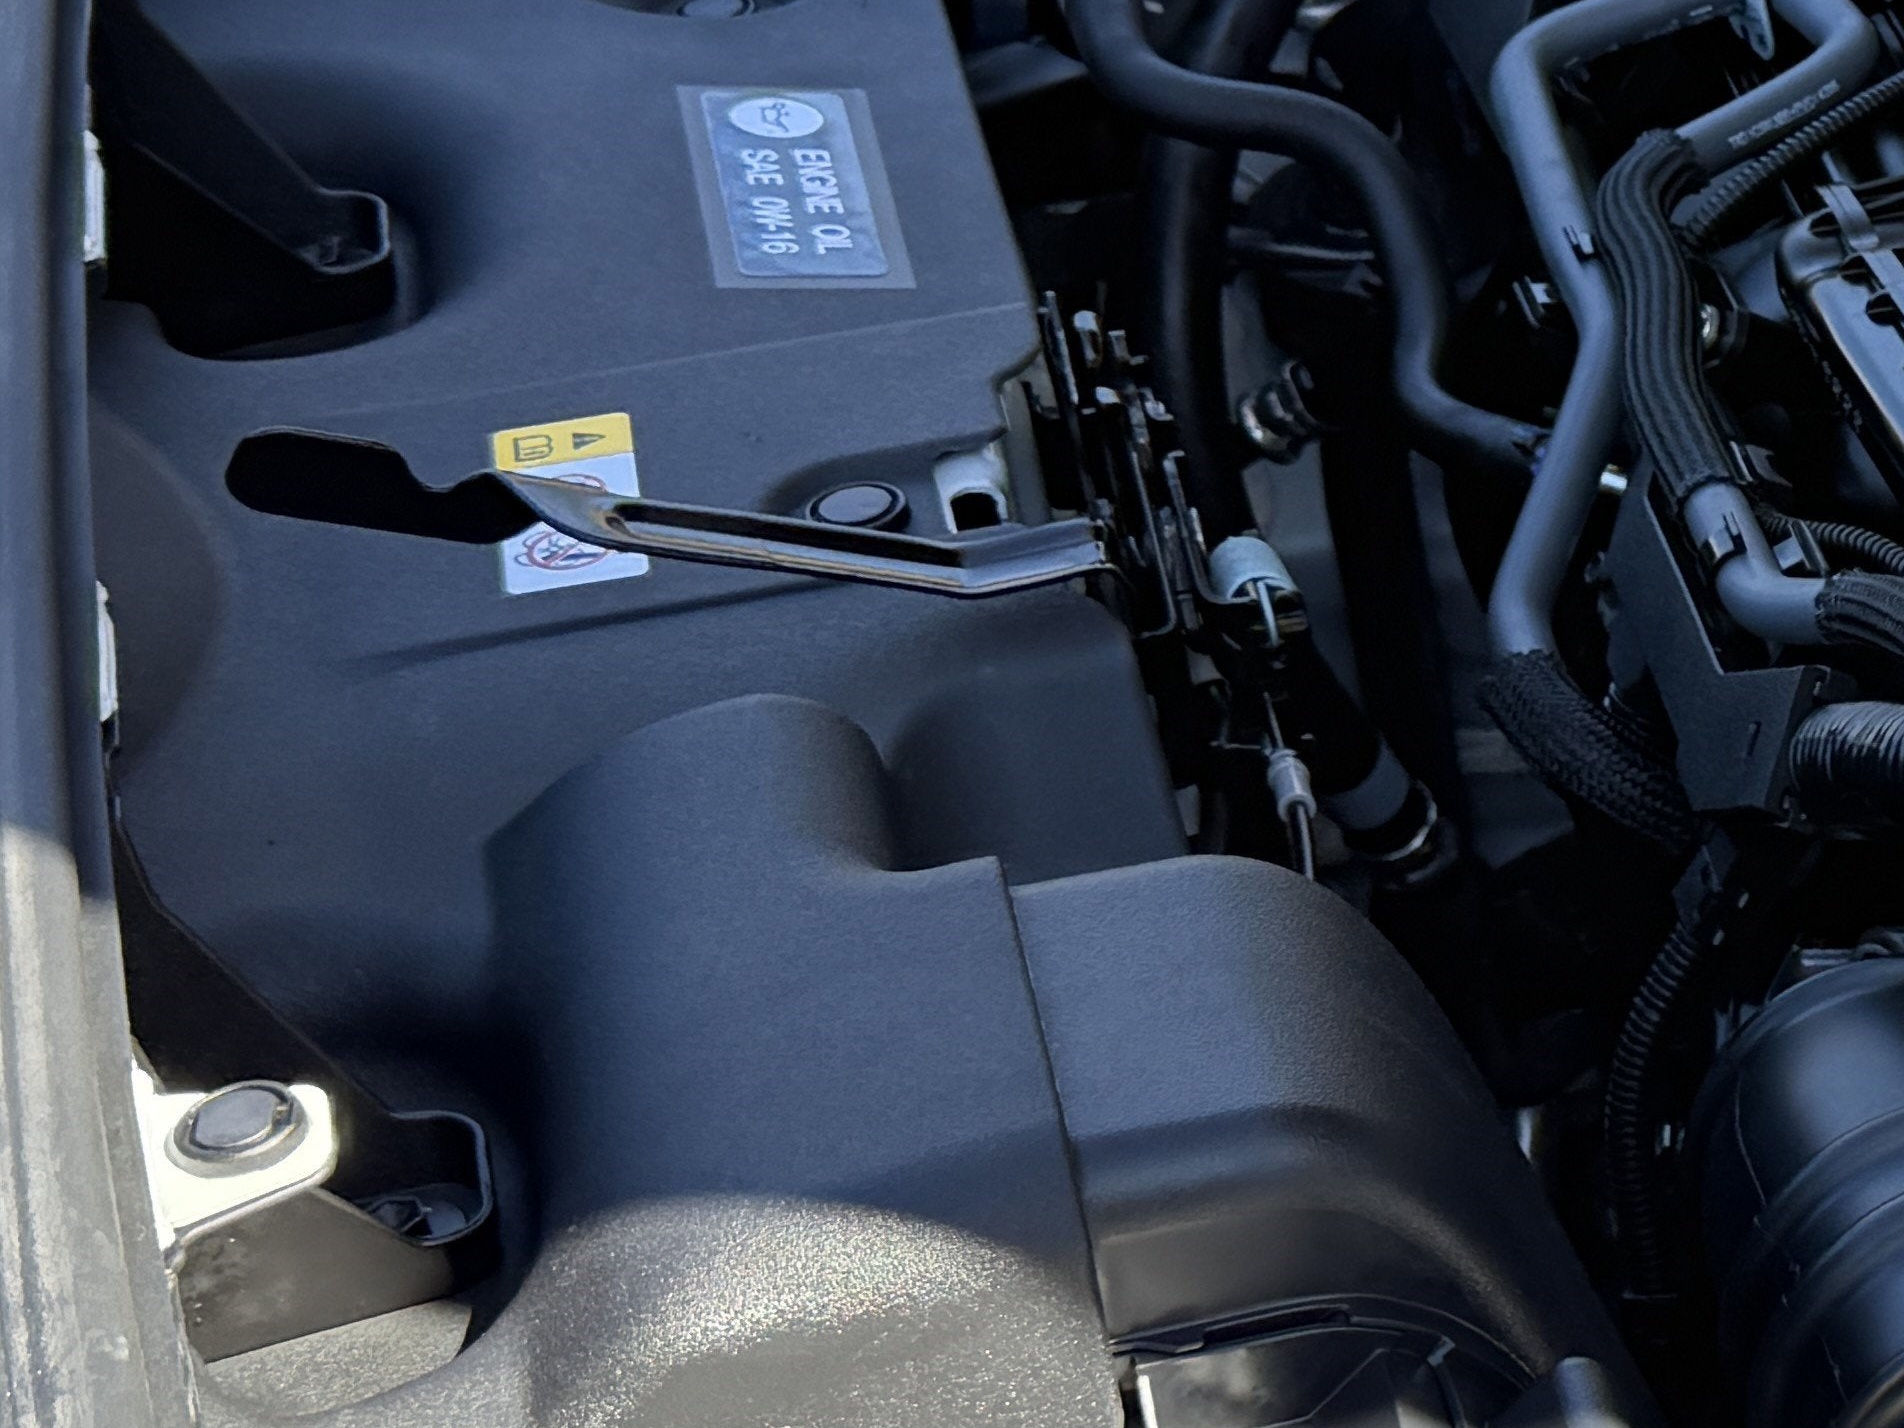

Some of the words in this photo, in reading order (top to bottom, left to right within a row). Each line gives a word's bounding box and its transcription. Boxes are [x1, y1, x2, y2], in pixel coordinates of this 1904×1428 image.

[741, 149, 784, 185] SAE
[793, 149, 844, 214] ENGINE
[751, 196, 799, 254] 0W-16
[811, 224, 853, 255] OIL
